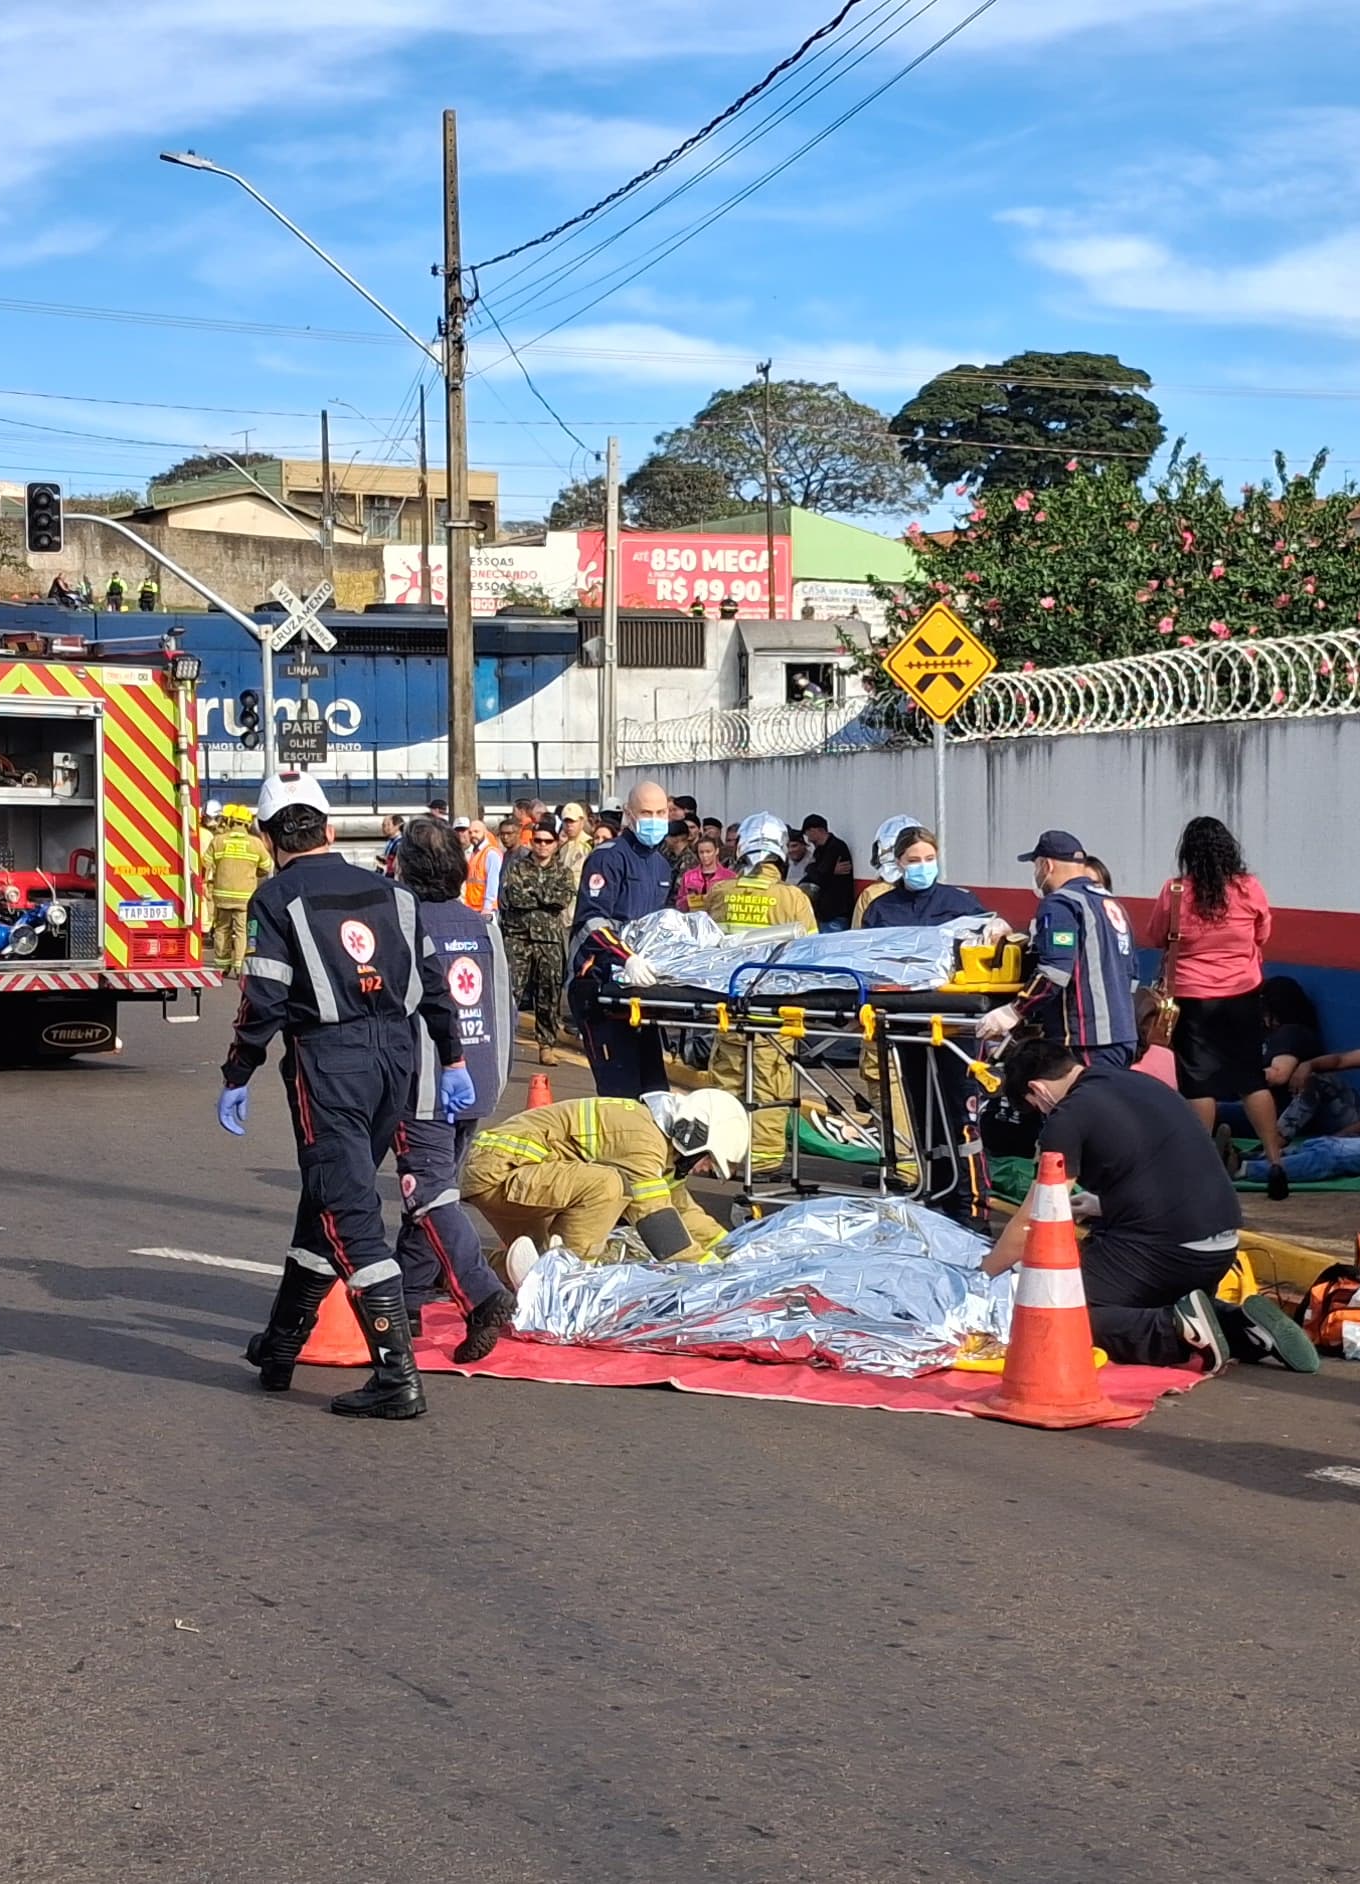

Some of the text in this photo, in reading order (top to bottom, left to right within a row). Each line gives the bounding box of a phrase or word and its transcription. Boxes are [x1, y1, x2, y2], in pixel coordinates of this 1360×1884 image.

[470, 557, 514, 567] ESSOAS
[650, 548, 697, 571] 850
[471, 570, 537, 580] ONECTANDO
[470, 582, 513, 591] ESSOAS
[657, 577, 688, 604] R$
[278, 586, 294, 607] VIA
[272, 582, 332, 648] CRUZAMENTO
[287, 665, 320, 677] LINHA
[282, 722, 324, 735] PARE
[289, 739, 318, 749] OLHE
[283, 753, 324, 762] ESCUTE
[724, 894, 777, 906] BOMBEIRO
[727, 904, 769, 914] MILITAR
[360, 976, 384, 993] 192
[459, 1008, 482, 1018] SAMU
[461, 1020, 484, 1036] 192
